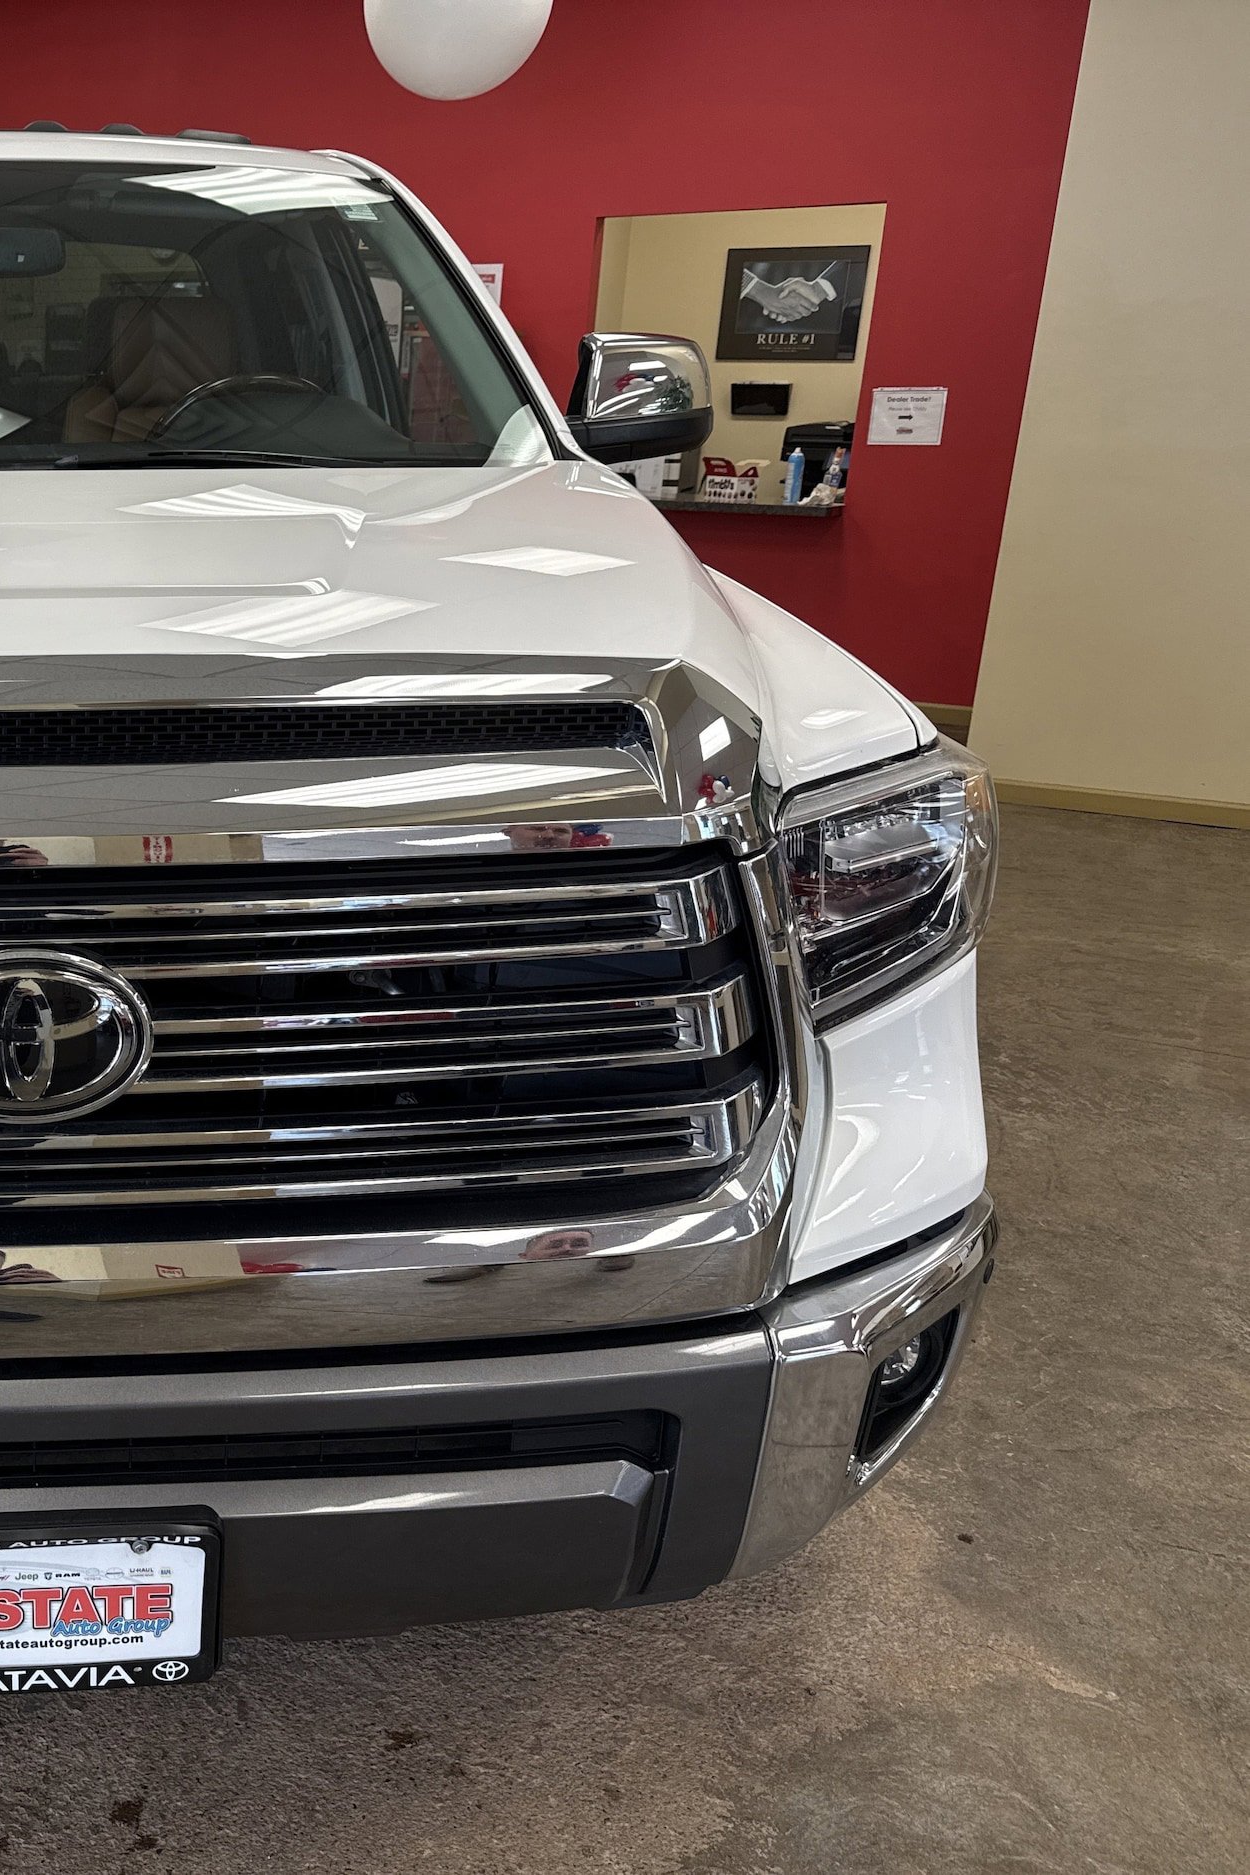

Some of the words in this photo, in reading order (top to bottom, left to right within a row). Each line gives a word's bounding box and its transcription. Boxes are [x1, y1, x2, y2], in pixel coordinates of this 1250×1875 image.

[756, 333, 798, 345] RULE
[802, 334, 815, 344] #1
[9, 1539, 88, 1549] AUTO
[98, 1536, 201, 1544] GROUP
[15, 1572, 38, 1581] Jeep
[51, 1619, 102, 1637] Auto
[107, 1617, 170, 1637] Group
